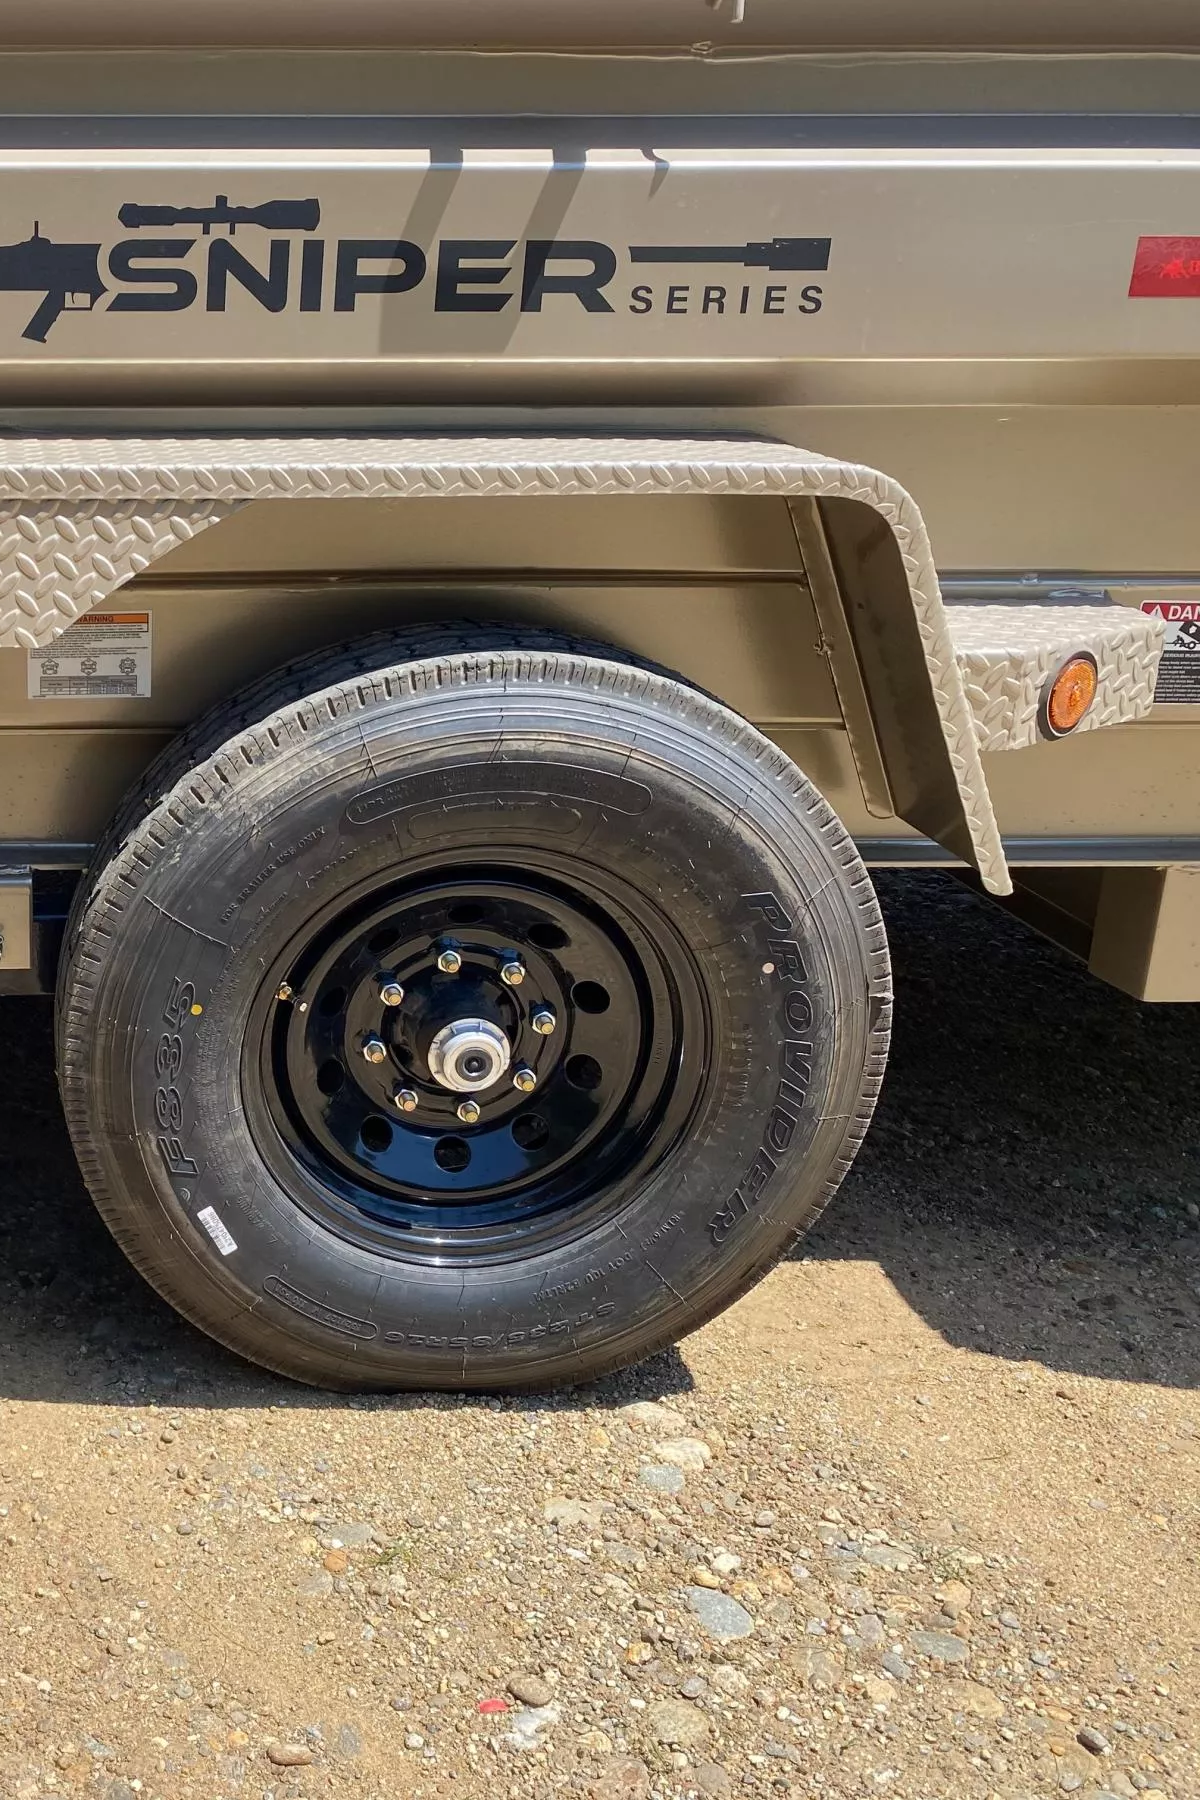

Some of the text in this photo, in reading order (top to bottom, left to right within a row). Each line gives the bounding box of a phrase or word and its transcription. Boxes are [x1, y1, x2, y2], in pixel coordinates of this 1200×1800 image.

[105, 238, 617, 314] SNIPER
[629, 285, 825, 315] SERIES
[154, 975, 200, 1178] F835
[705, 890, 814, 1248] PROVIDER
[574, 1301, 616, 1329] ST
